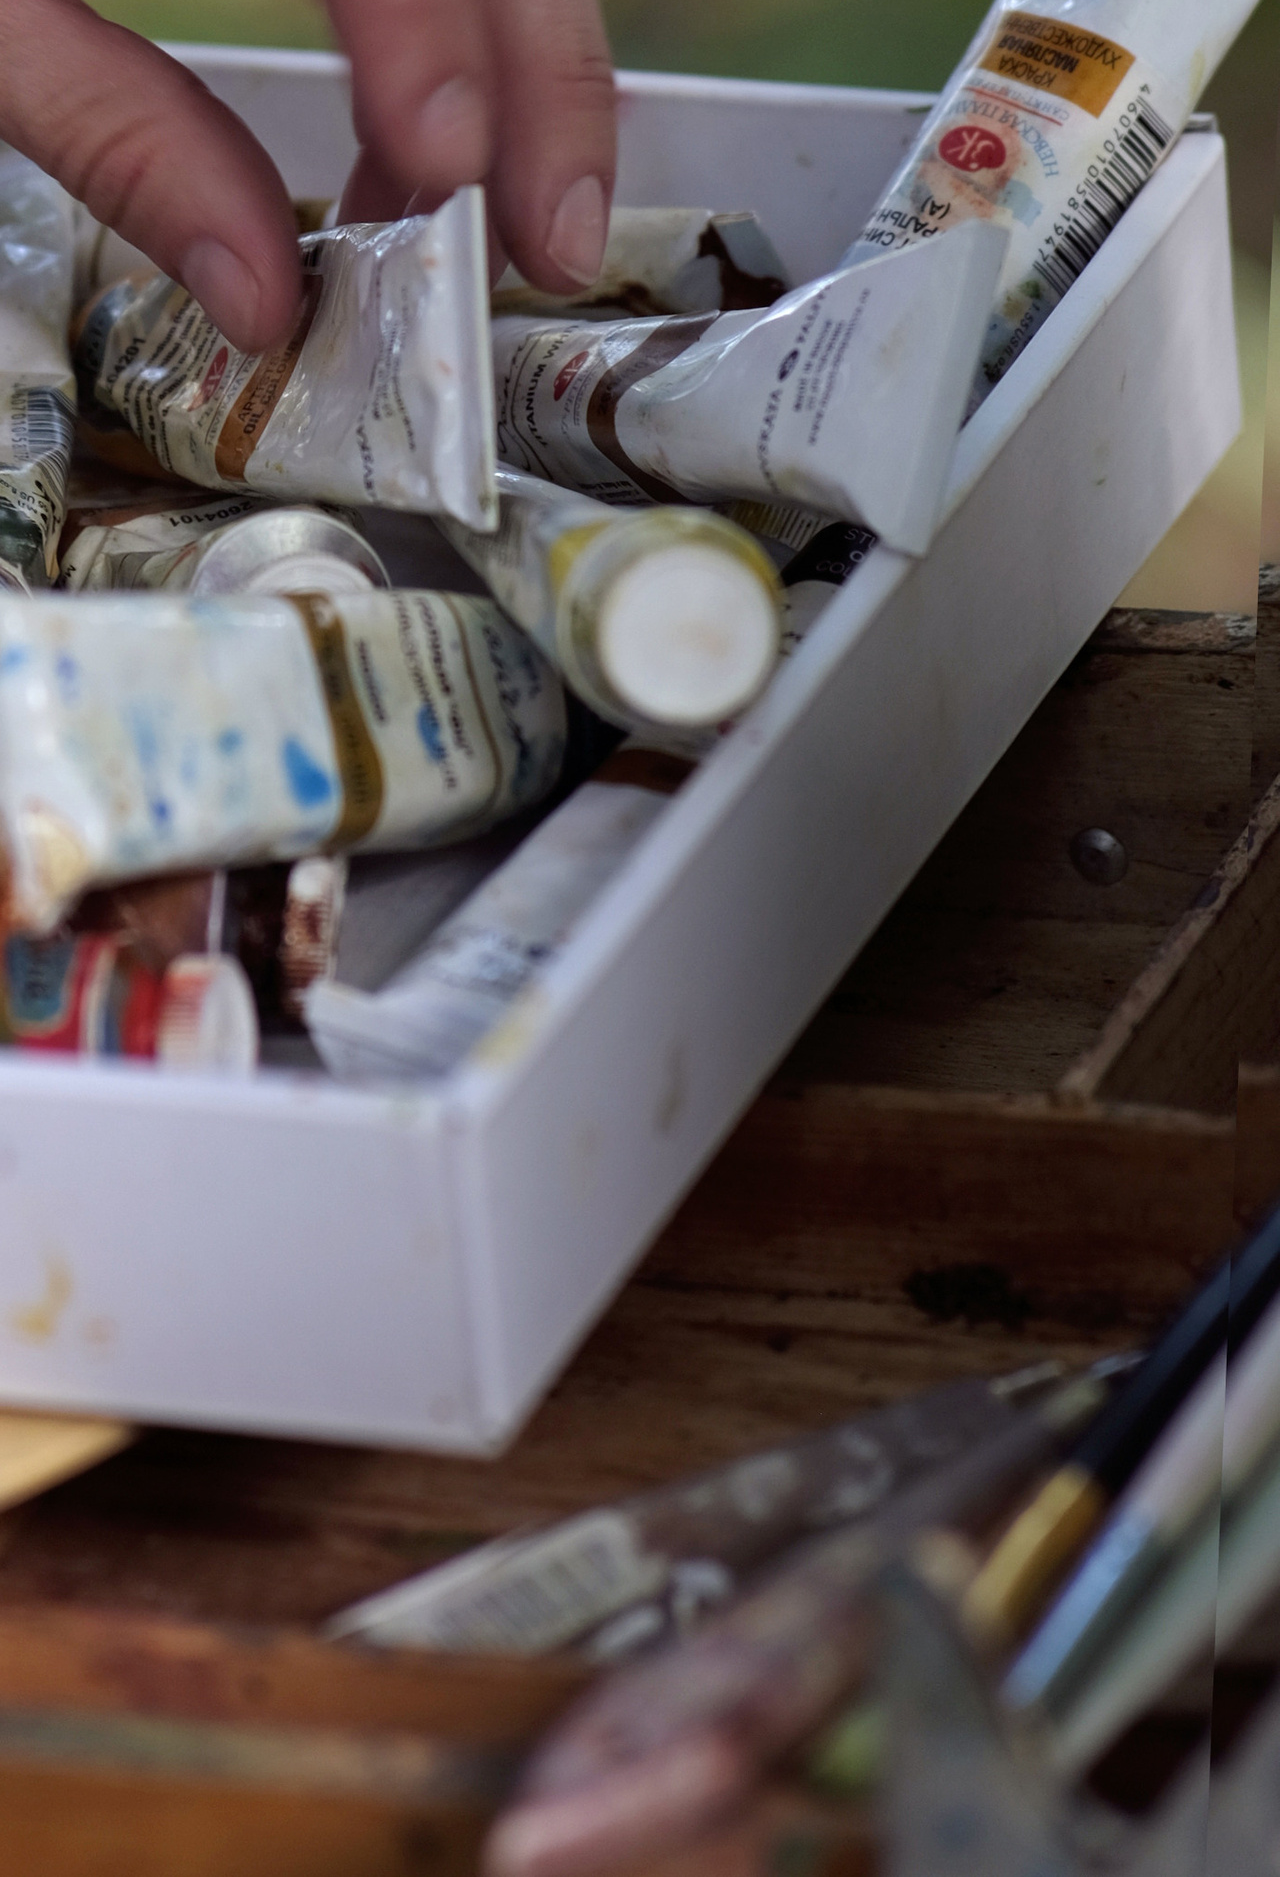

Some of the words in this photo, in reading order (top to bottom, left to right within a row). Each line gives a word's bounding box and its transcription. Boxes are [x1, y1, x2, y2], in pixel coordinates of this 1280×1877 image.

[996, 32, 1080, 76] МАСЛЯНАЯ
[996, 55, 1057, 89] КРАСКА
[992, 106, 1060, 179] НЕВСКАЯ
[241, 406, 265, 437] OIL
[168, 500, 253, 528] 2604101
